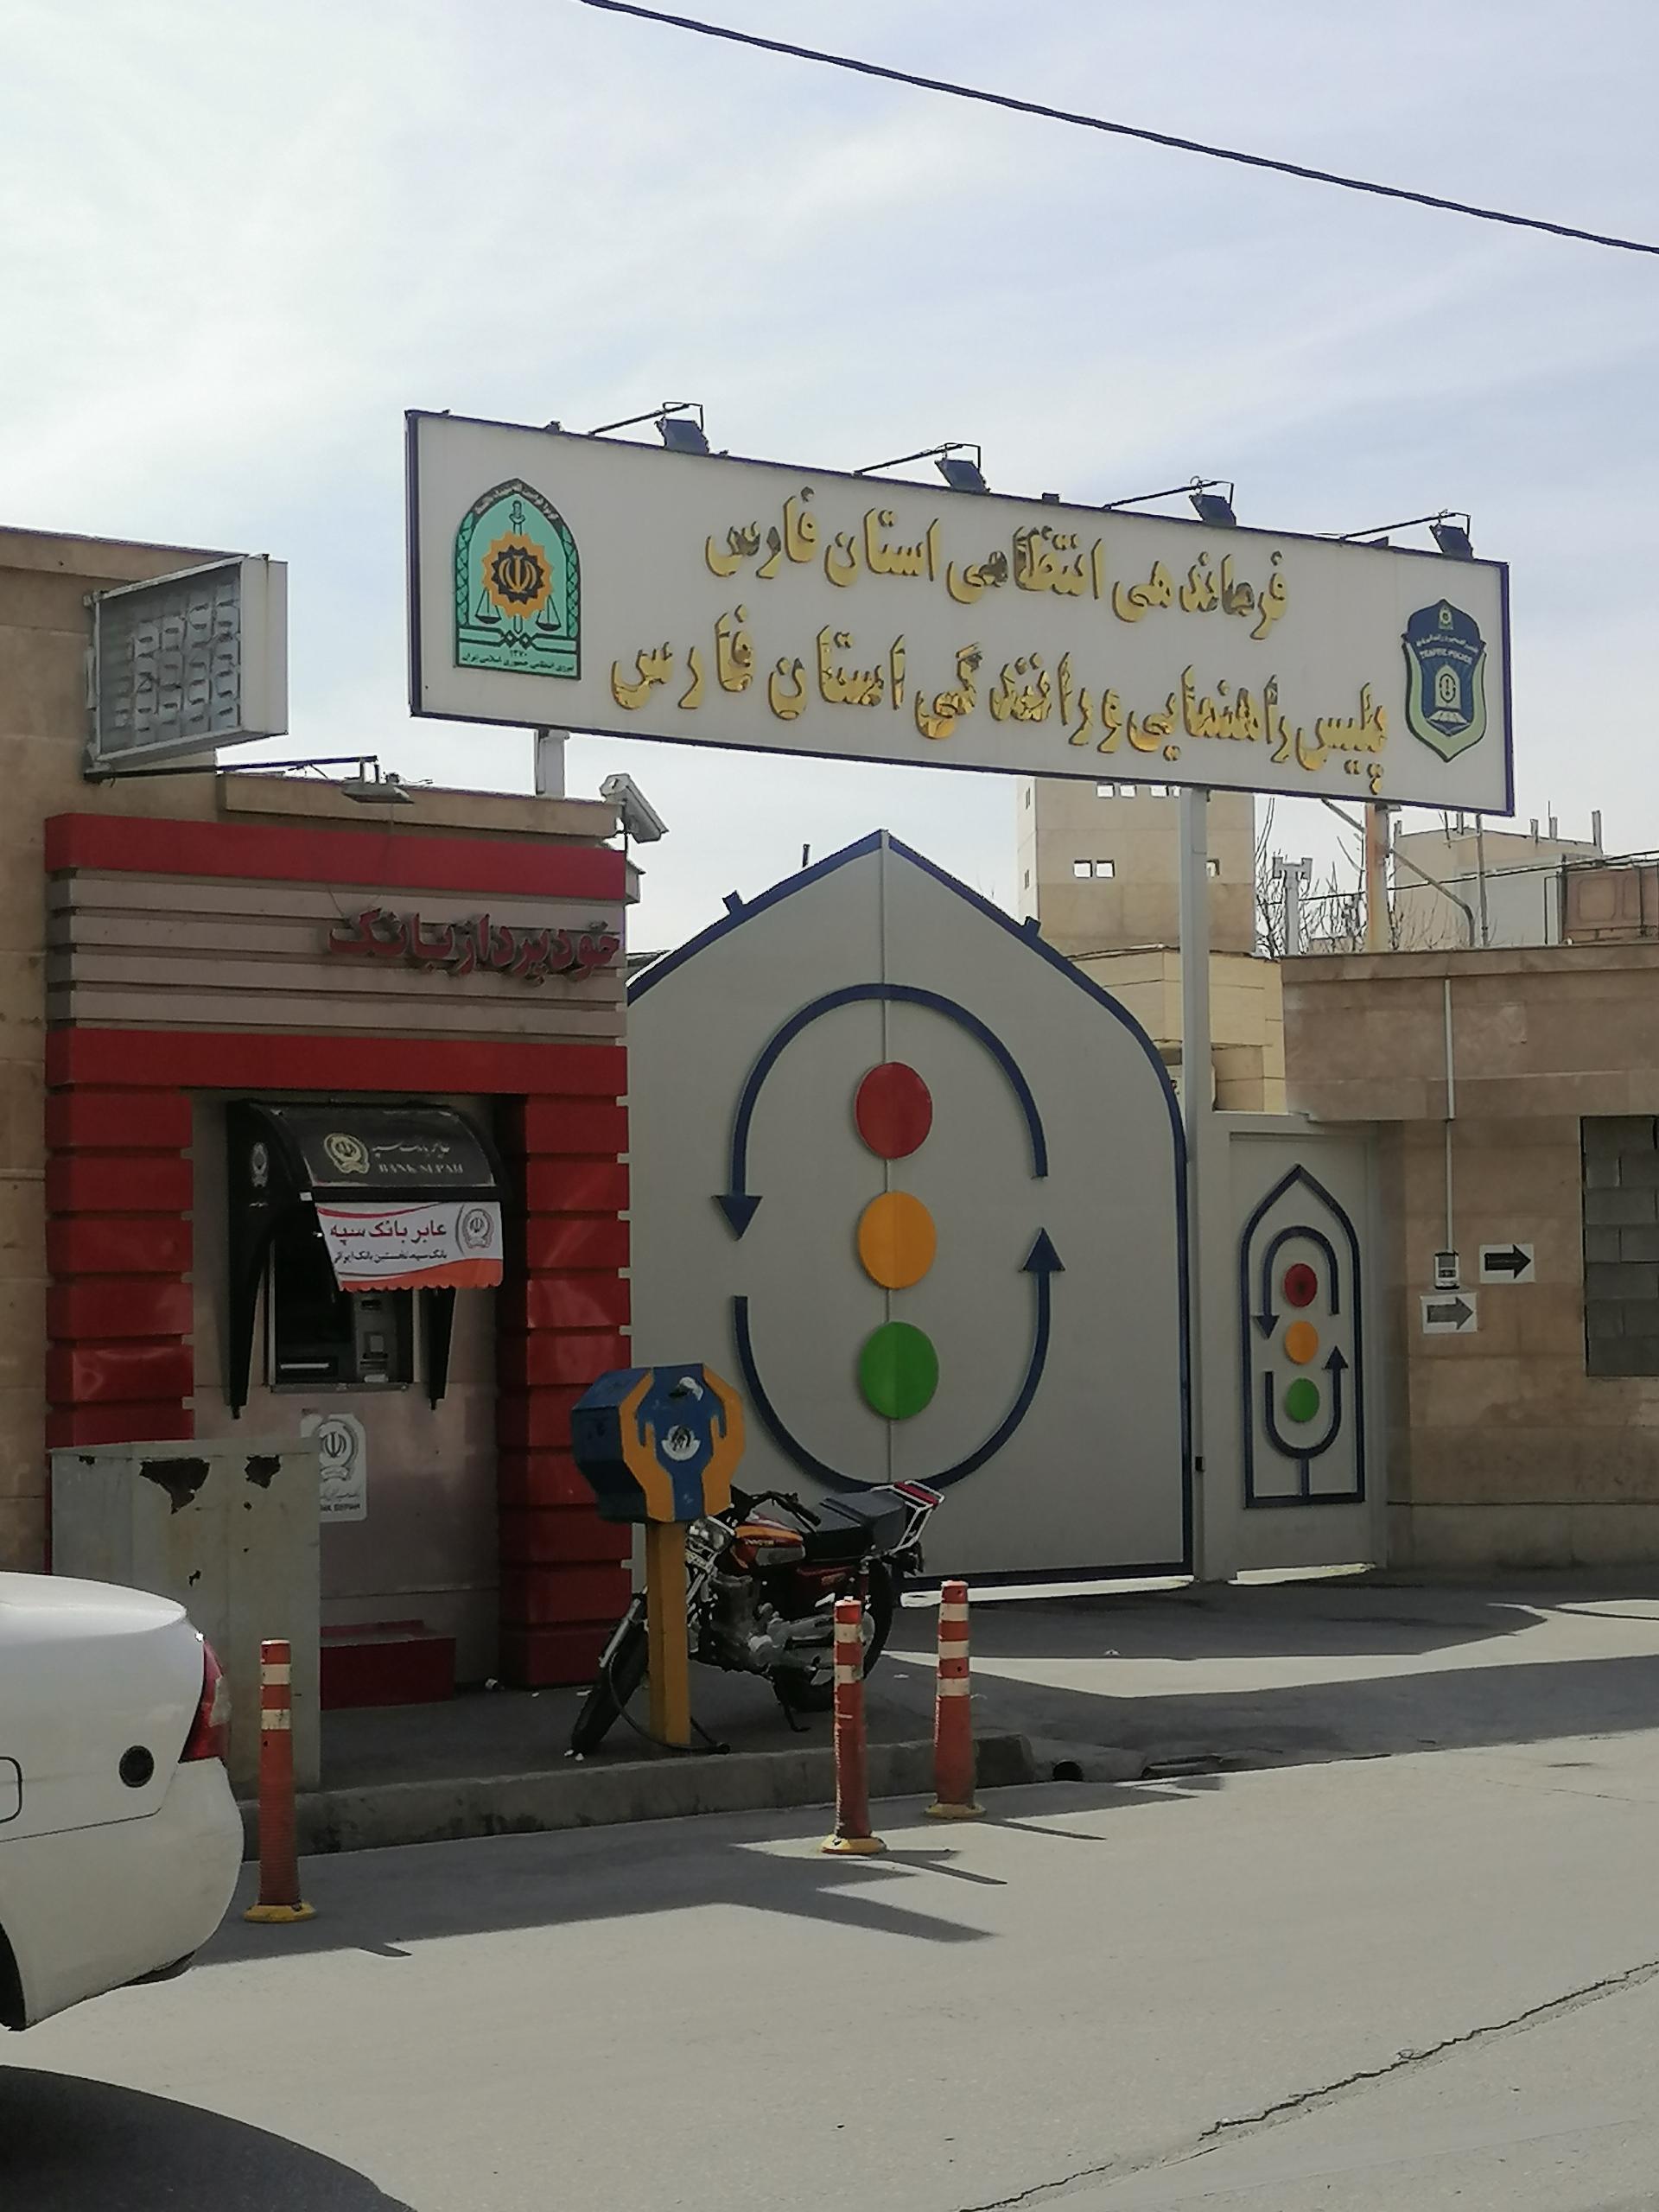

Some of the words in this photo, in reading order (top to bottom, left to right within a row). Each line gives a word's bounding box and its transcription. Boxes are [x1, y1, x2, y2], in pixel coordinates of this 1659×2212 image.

[704, 486, 817, 580] فارس
[823, 507, 940, 588] استان
[946, 525, 1105, 605] انتظامی
[1111, 550, 1288, 640] فرماندهی
[610, 603, 754, 711] فارس
[767, 624, 906, 721] استان
[914, 641, 1093, 747] رانندگی
[1126, 664, 1292, 764] راهنمایی
[1295, 682, 1389, 796] پلیس
[328, 906, 454, 973] بانک
[454, 912, 620, 987] خودپرداز
[330, 1224, 366, 1246] سپه
[369, 1218, 409, 1244] بانک
[410, 1218, 448, 1245] عابر
